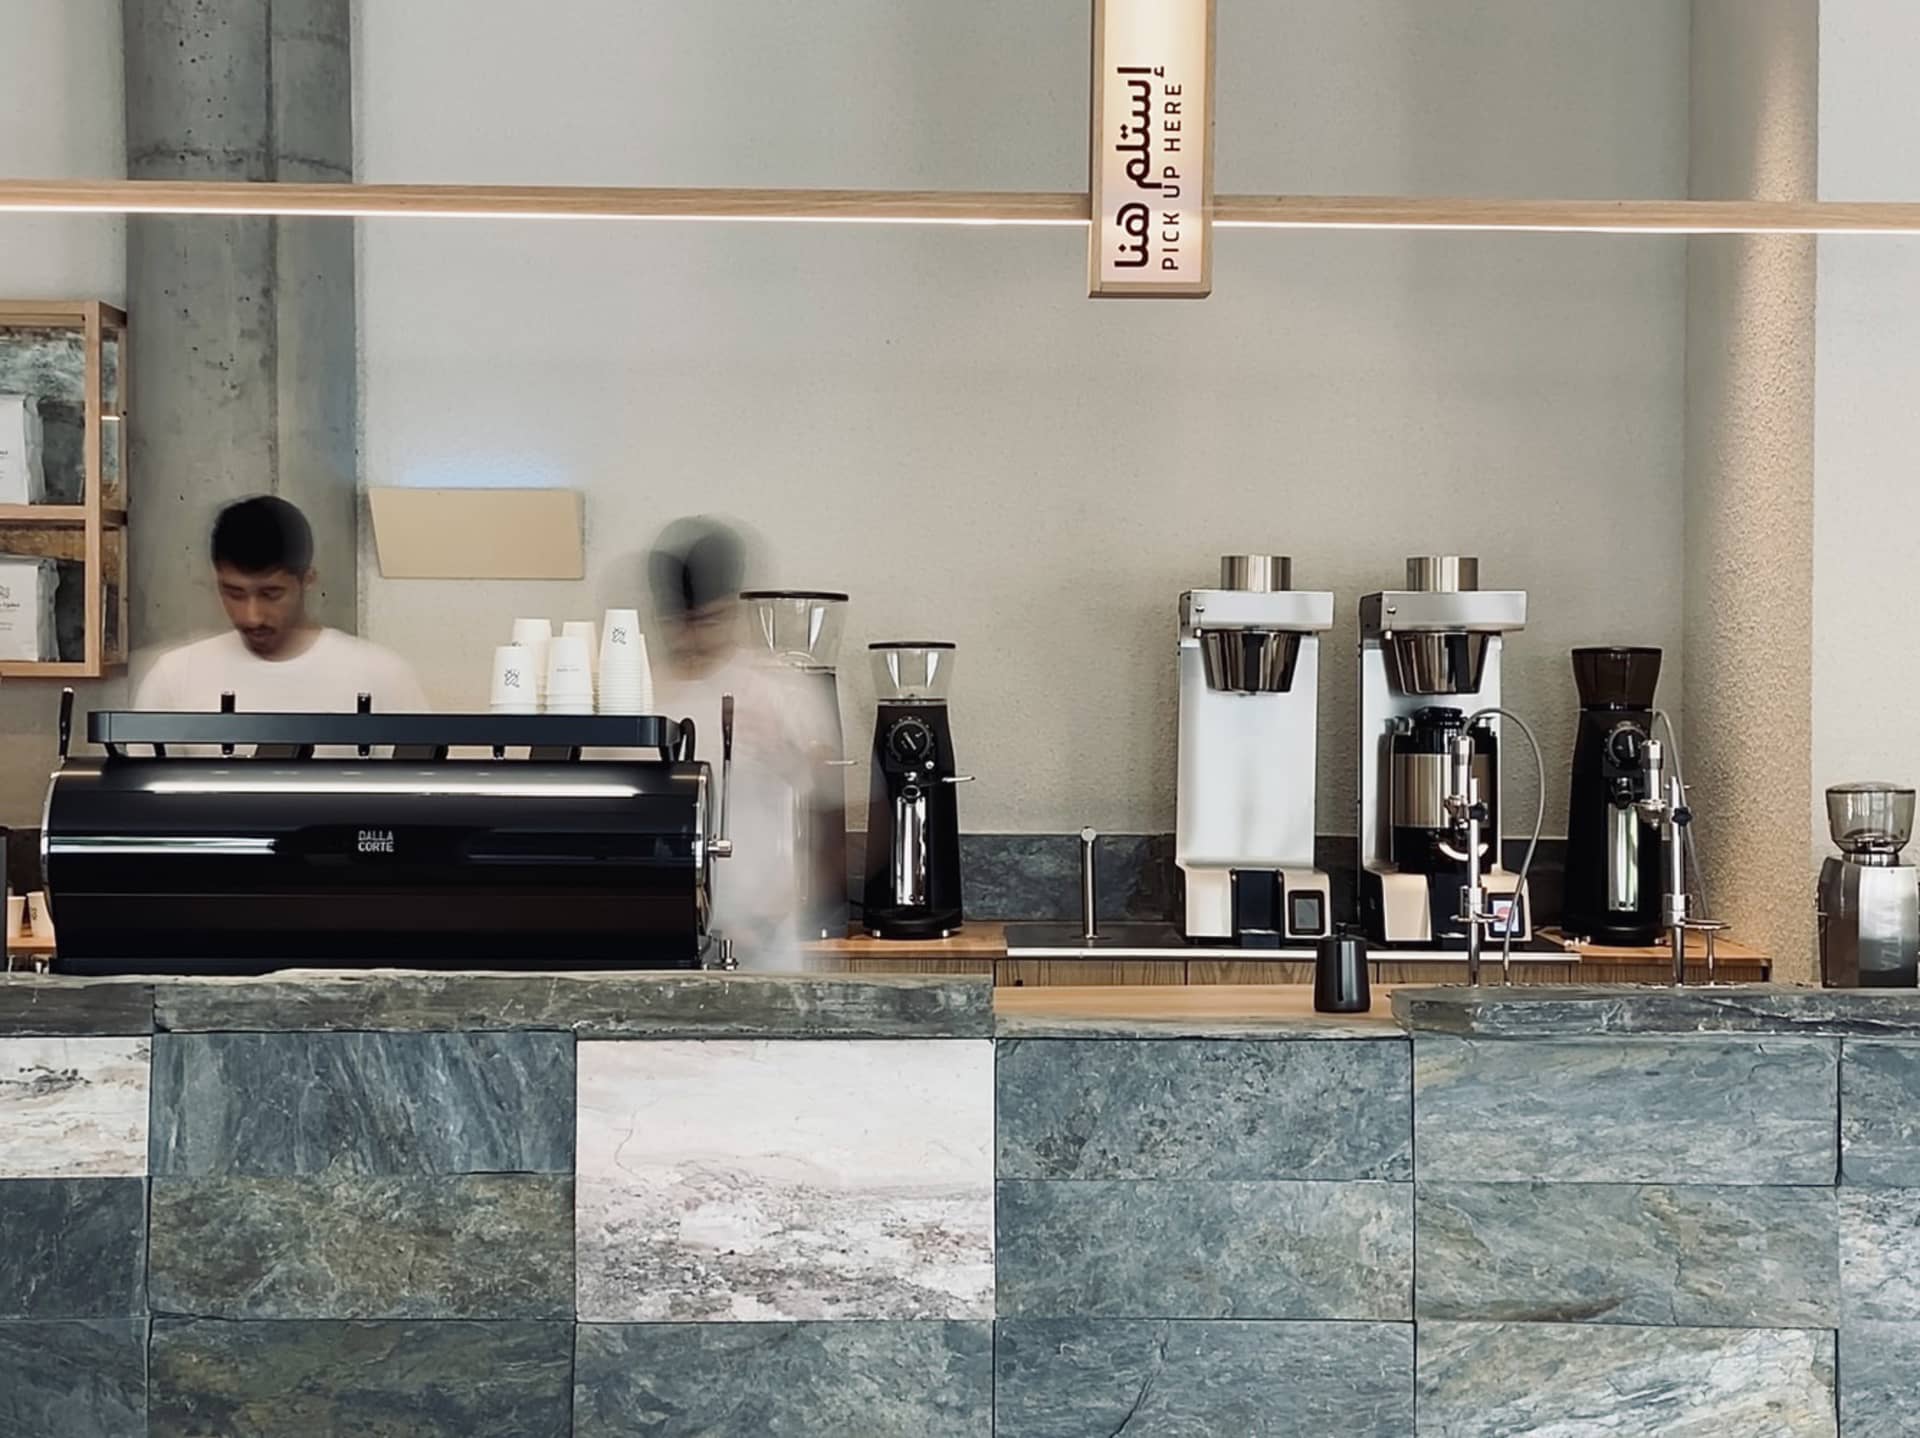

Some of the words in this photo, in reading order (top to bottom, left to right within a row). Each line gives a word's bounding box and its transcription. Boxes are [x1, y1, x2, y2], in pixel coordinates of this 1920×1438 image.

[1116, 67, 1164, 189] إستلم
[1164, 85, 1181, 151] HERE
[1163, 166, 1180, 198] UP
[1114, 203, 1149, 267] هنا
[1162, 213, 1179, 270] PICK
[358, 841, 393, 852] CORTE
[359, 831, 393, 841] DALLA
